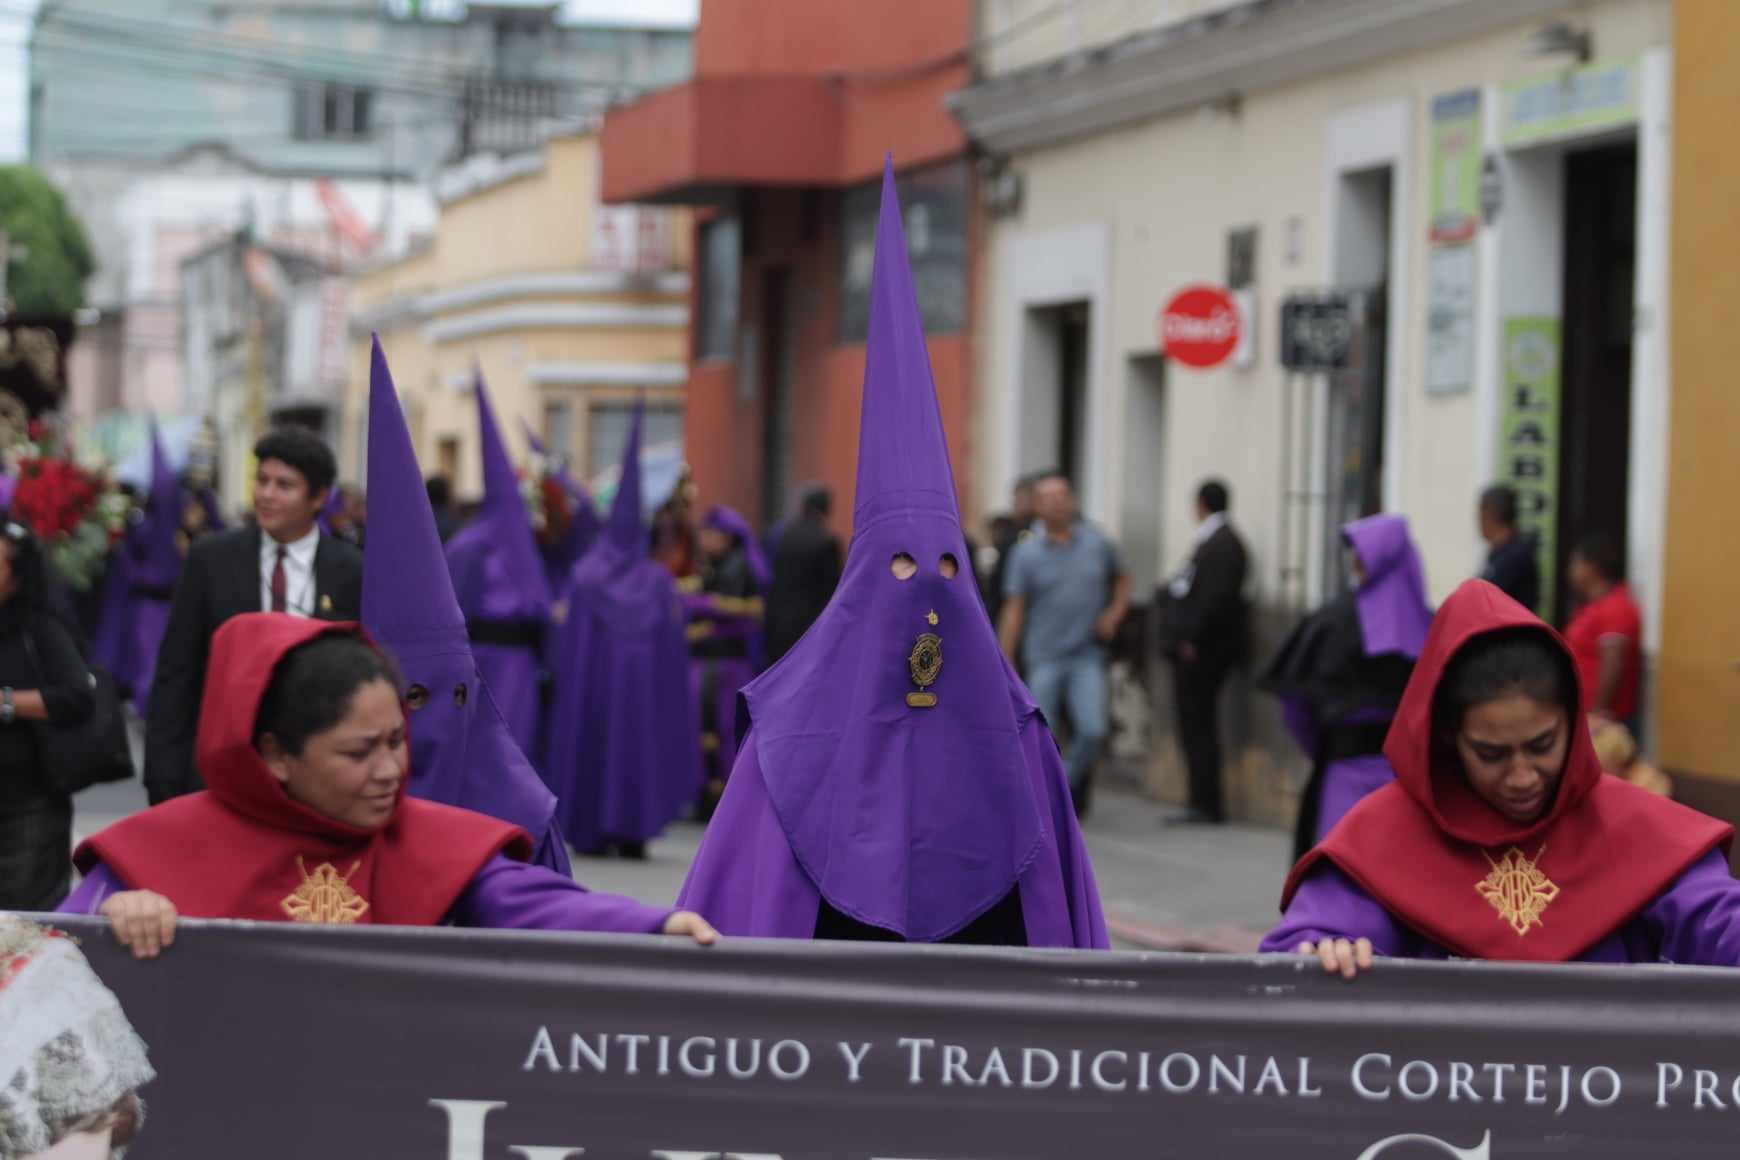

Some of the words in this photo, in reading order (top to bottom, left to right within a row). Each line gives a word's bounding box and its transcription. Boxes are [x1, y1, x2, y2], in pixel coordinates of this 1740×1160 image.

[522, 1026, 811, 1079] ANTIGUO
[838, 1041, 872, 1082] Y
[897, 1037, 1322, 1097] TRADICIONAL
[1350, 1052, 1622, 1113] CORTEJO
[1655, 1062, 1740, 1109] PR
